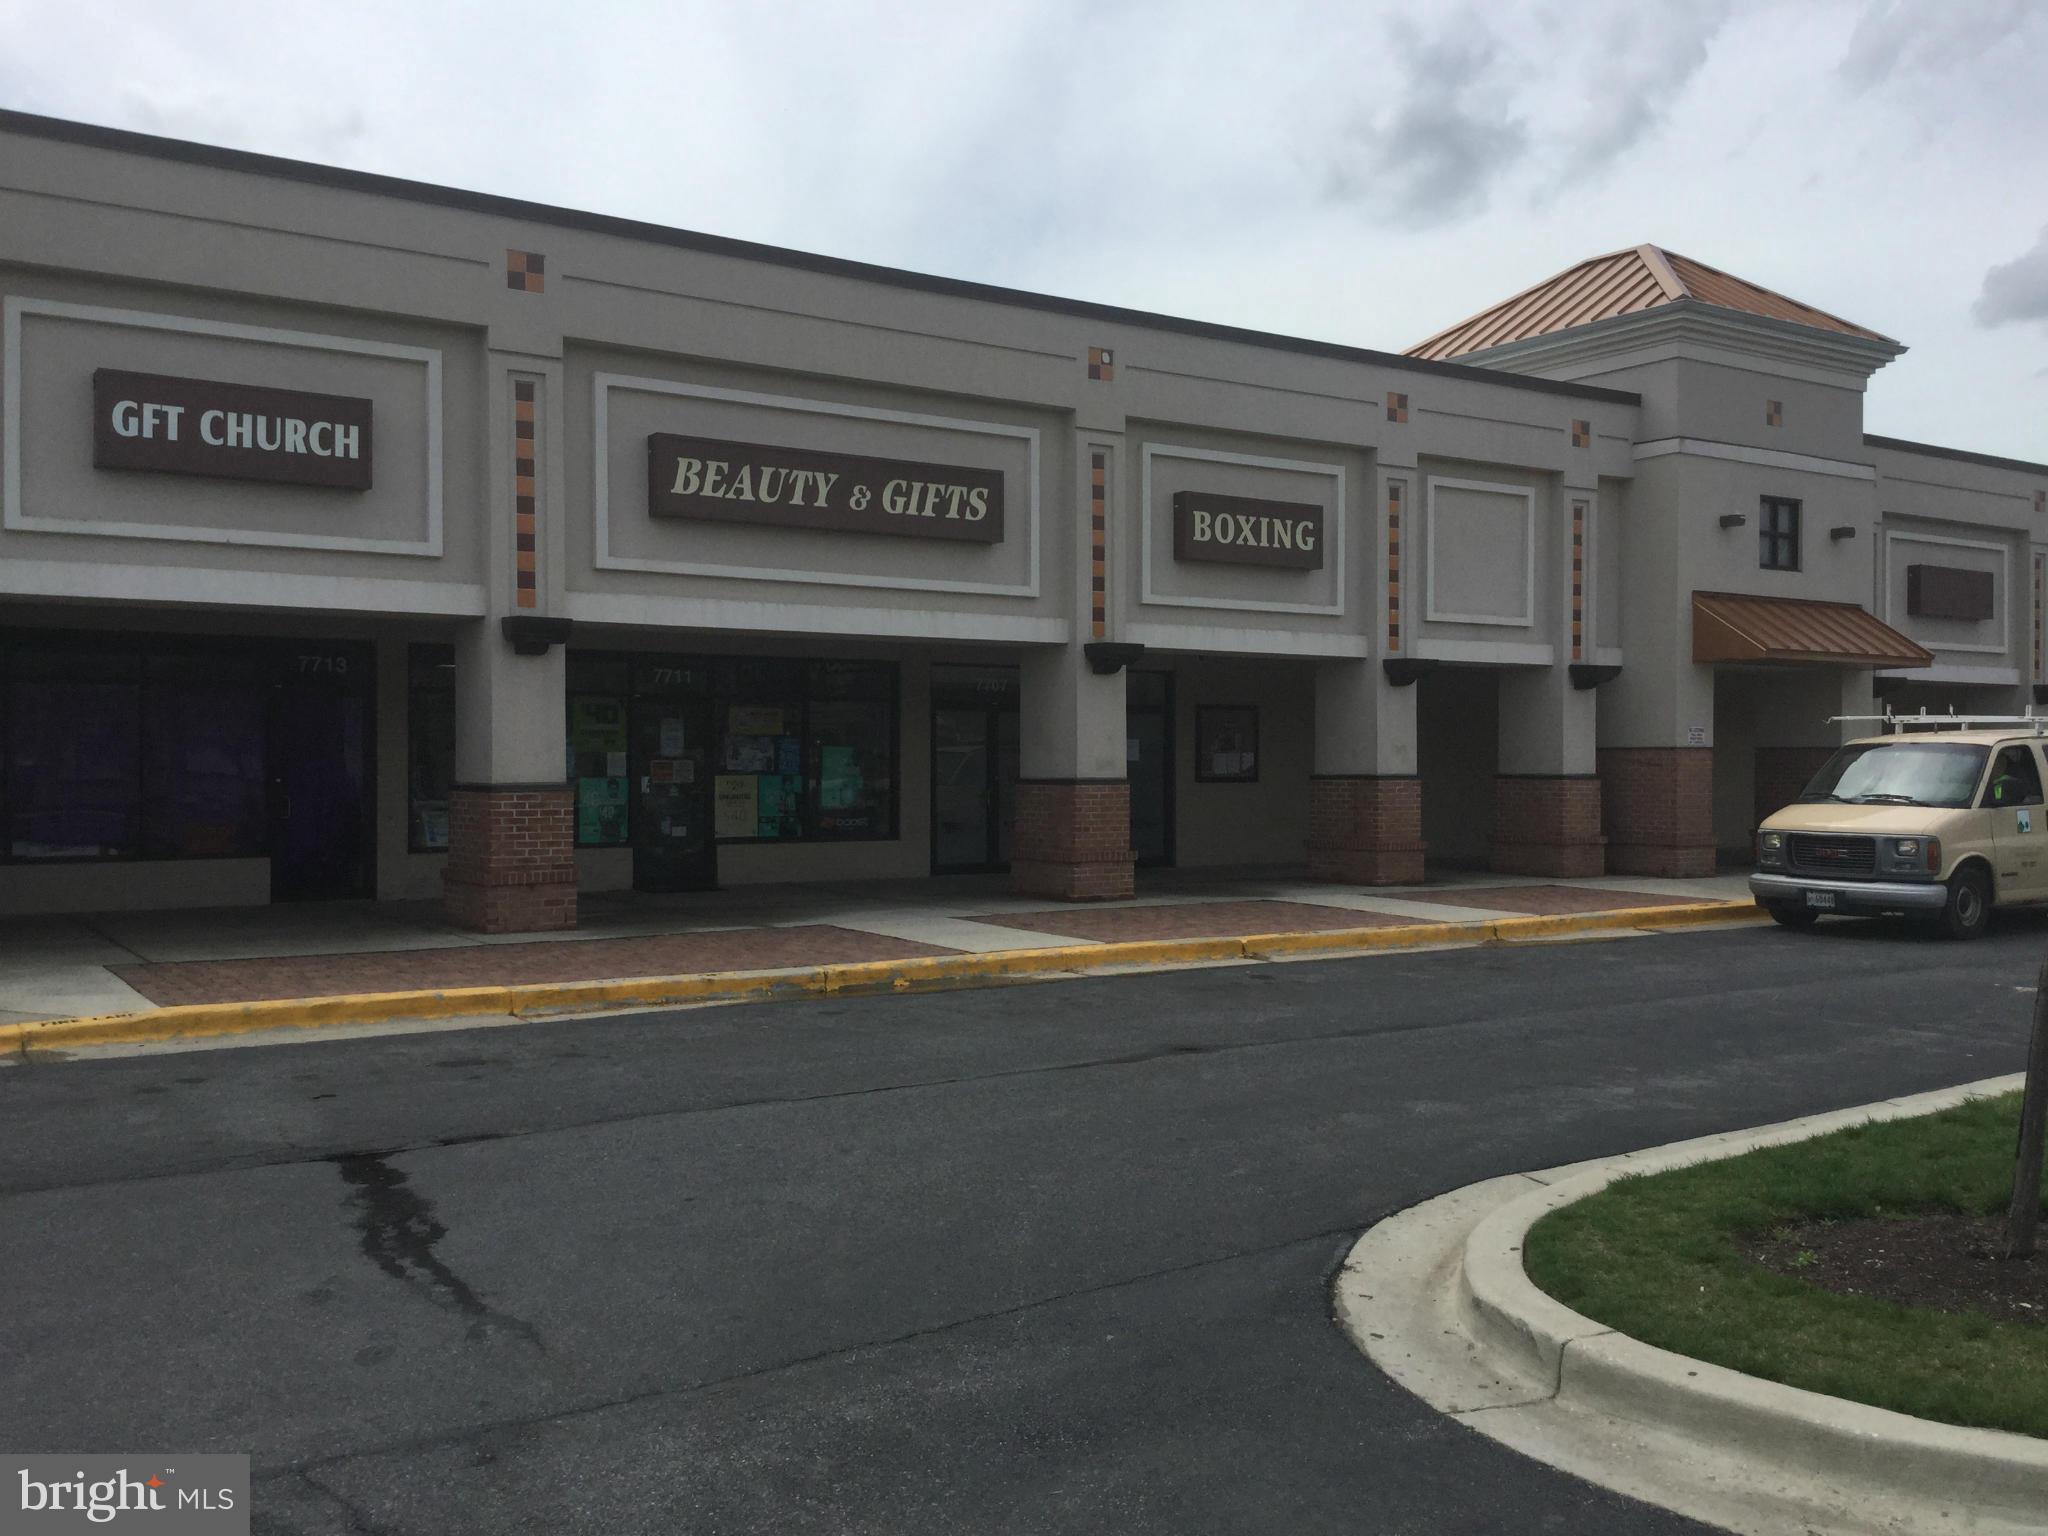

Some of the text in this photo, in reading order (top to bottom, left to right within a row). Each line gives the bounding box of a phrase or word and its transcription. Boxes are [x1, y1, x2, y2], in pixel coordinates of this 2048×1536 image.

[112, 400, 359, 459] GFT CHURCH
[671, 456, 988, 521] BEAUTY & GIFTS
[1193, 510, 1315, 551] BOXING
[297, 655, 348, 673] 7713
[653, 667, 692, 686] 7711
